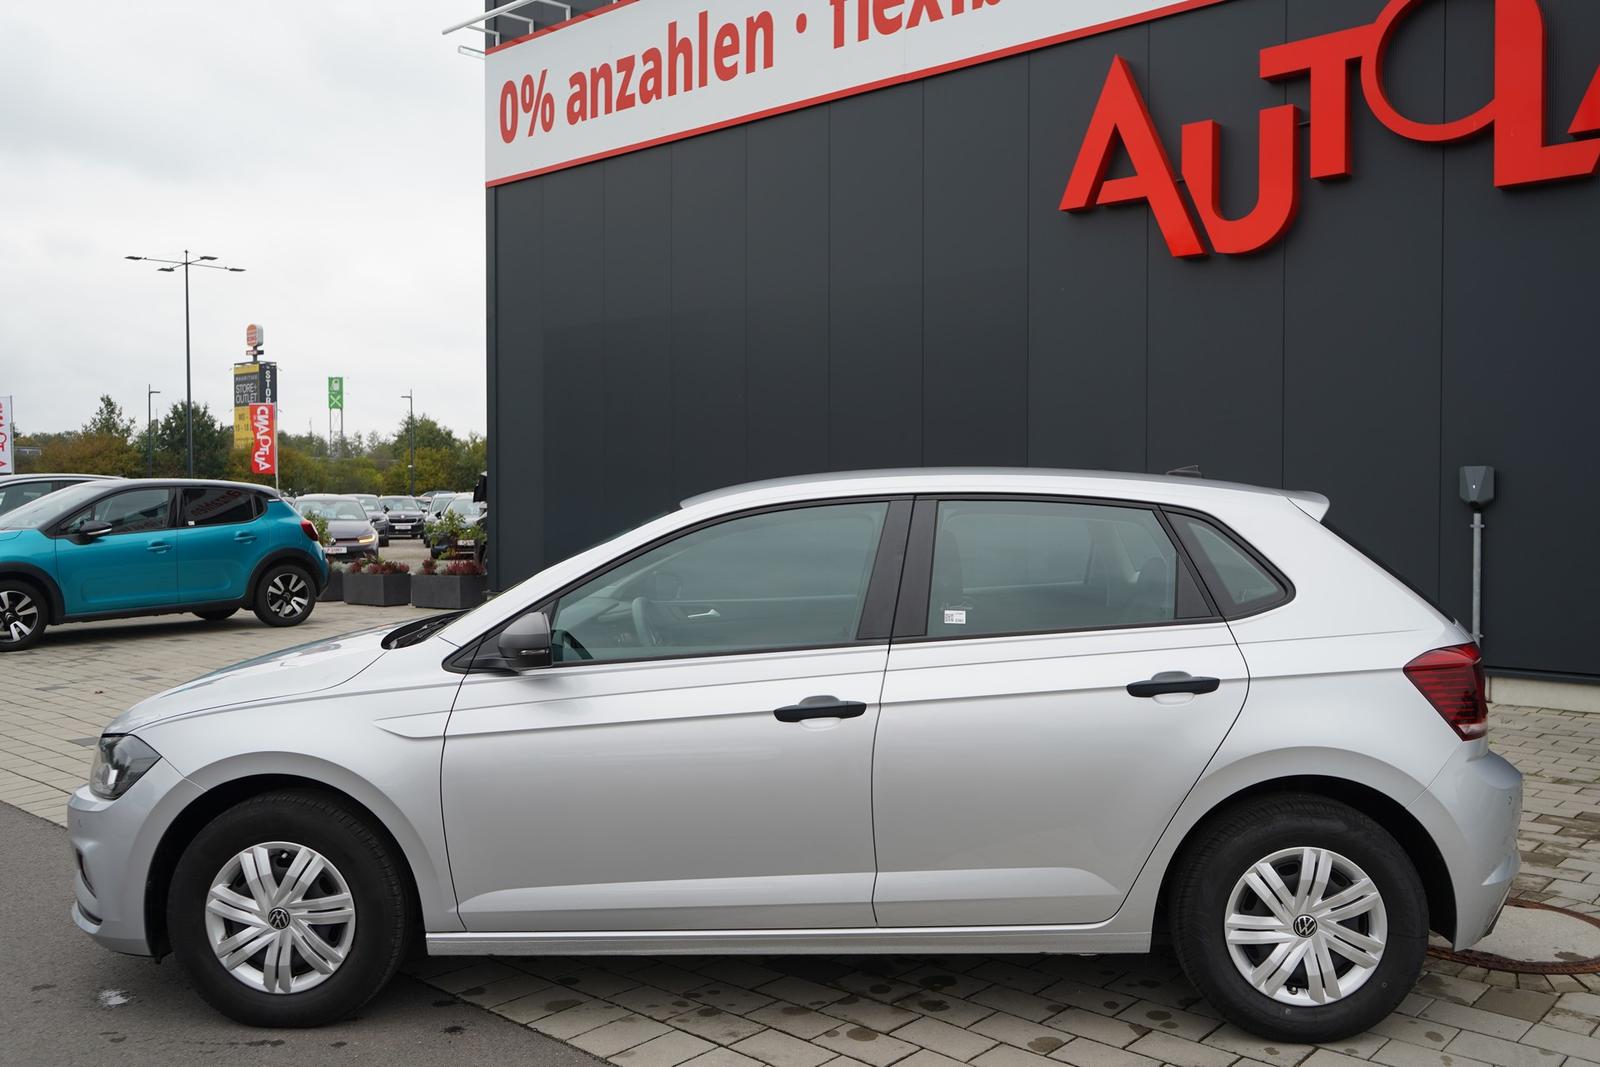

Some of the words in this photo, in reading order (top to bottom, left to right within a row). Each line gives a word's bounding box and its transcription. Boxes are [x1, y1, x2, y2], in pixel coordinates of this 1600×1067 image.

[499, 68, 556, 144] 0%
[565, 9, 775, 126] anzahlen
[235, 393, 257, 404] OUTLET
